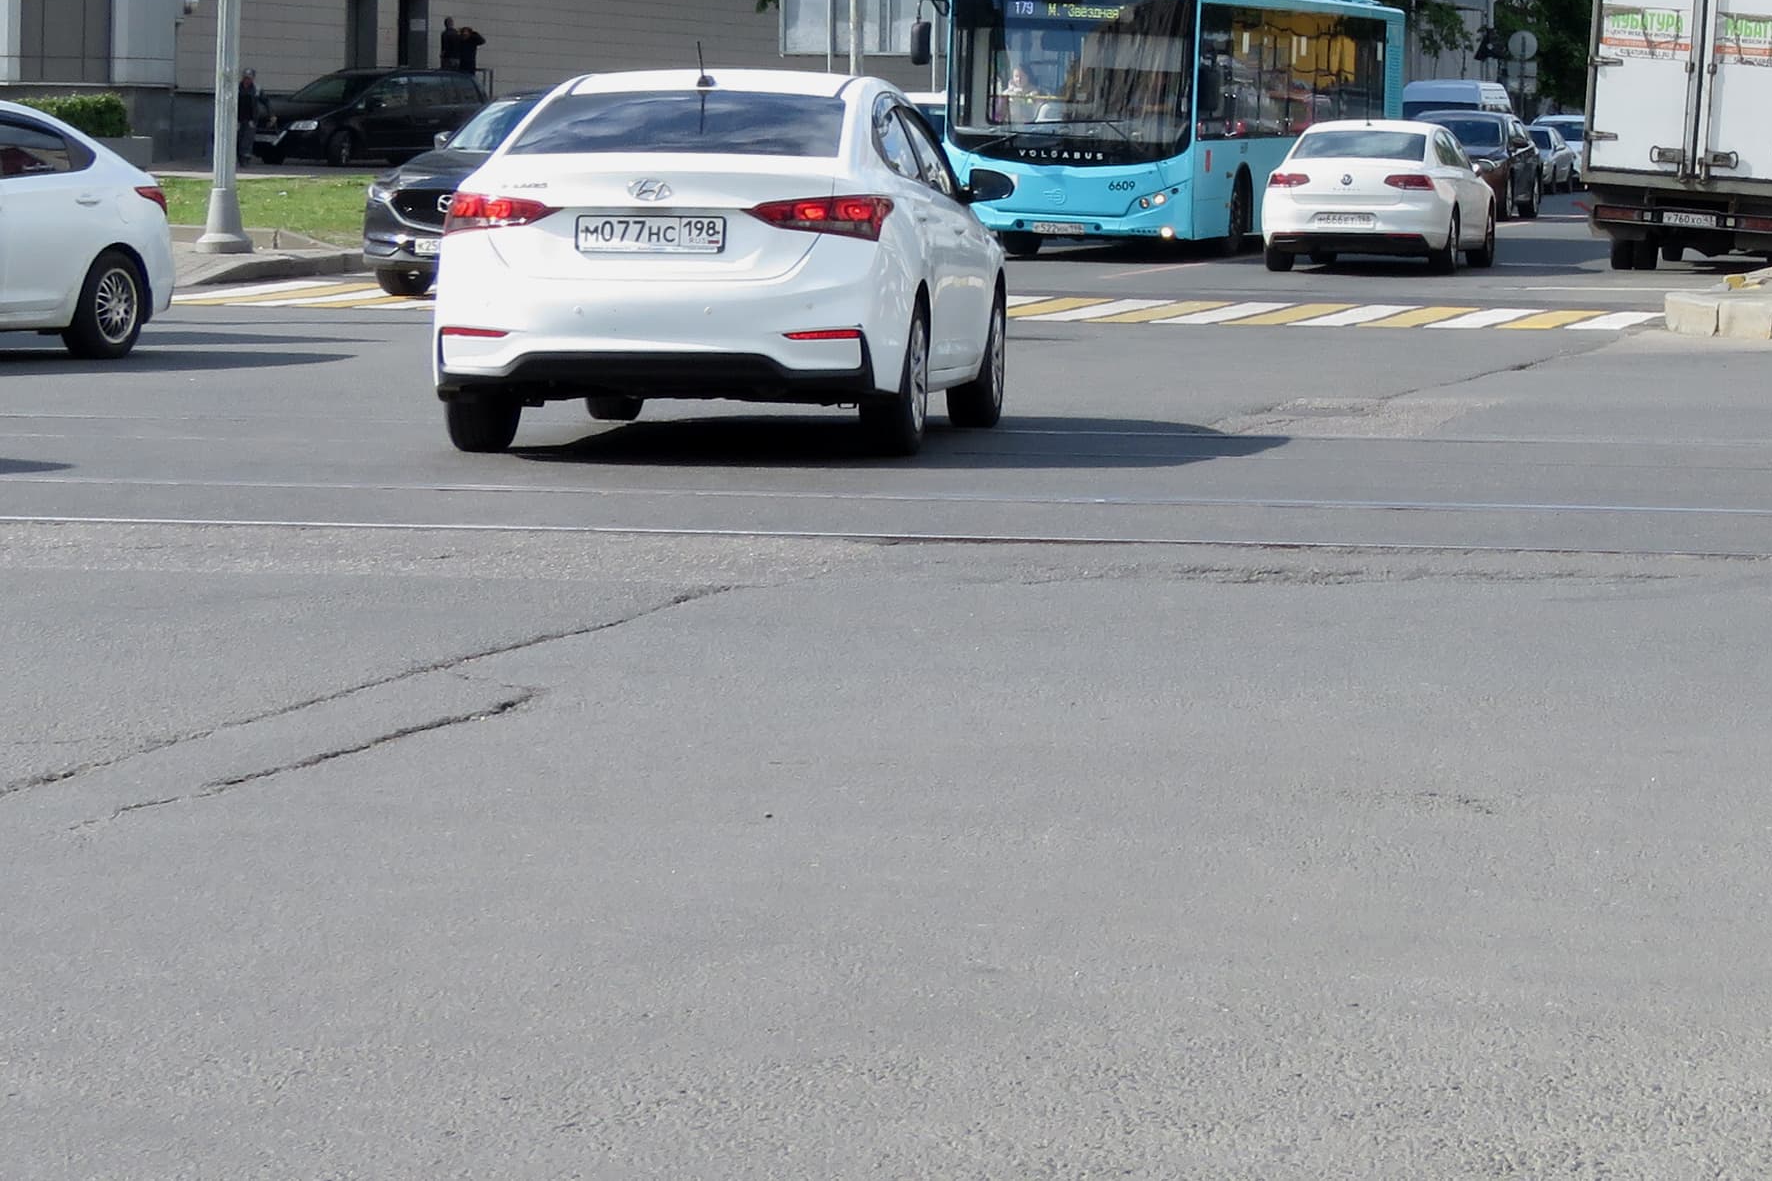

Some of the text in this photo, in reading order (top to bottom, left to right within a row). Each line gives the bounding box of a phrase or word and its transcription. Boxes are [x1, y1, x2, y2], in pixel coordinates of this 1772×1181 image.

[1015, 1, 1034, 15] 179
[1019, 149, 1104, 160] VOLGABUS
[1108, 181, 1136, 191] 6609
[584, 220, 717, 243] М077НС 198
